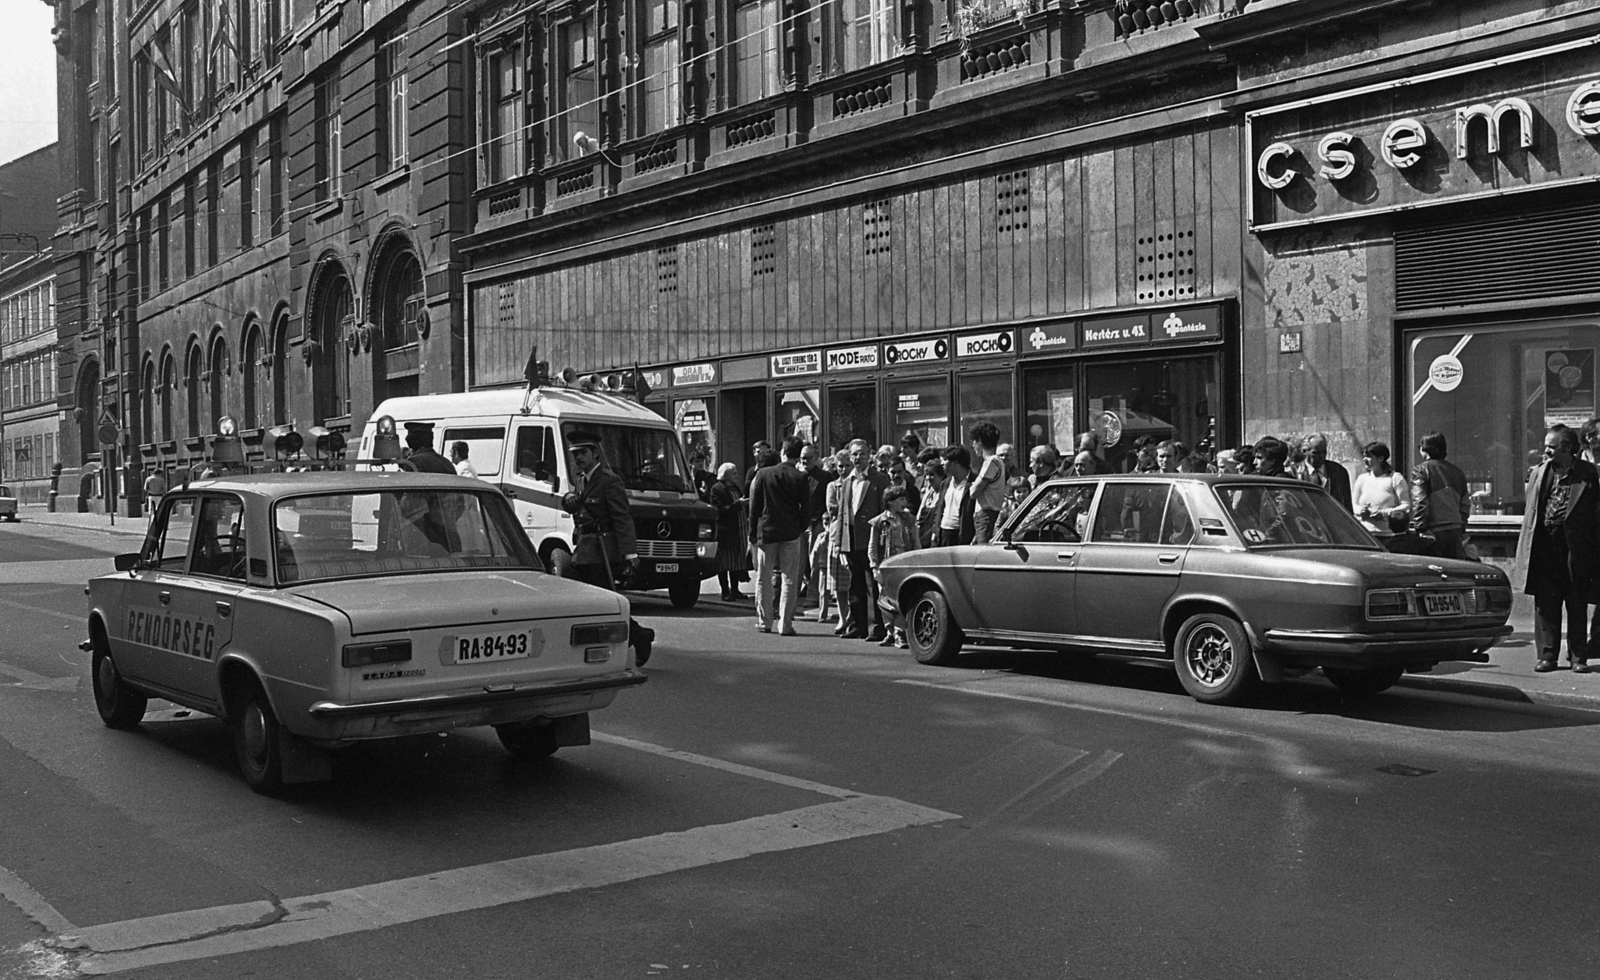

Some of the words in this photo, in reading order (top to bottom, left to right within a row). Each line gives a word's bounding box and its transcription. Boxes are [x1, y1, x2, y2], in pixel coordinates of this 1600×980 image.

[1085, 328, 1120, 341] Kertész
[896, 346, 929, 361] ROCKY
[966, 339, 999, 354] ROCKY
[1248, 530, 1261, 541] H
[128, 610, 214, 659] RENDŐRSÉG
